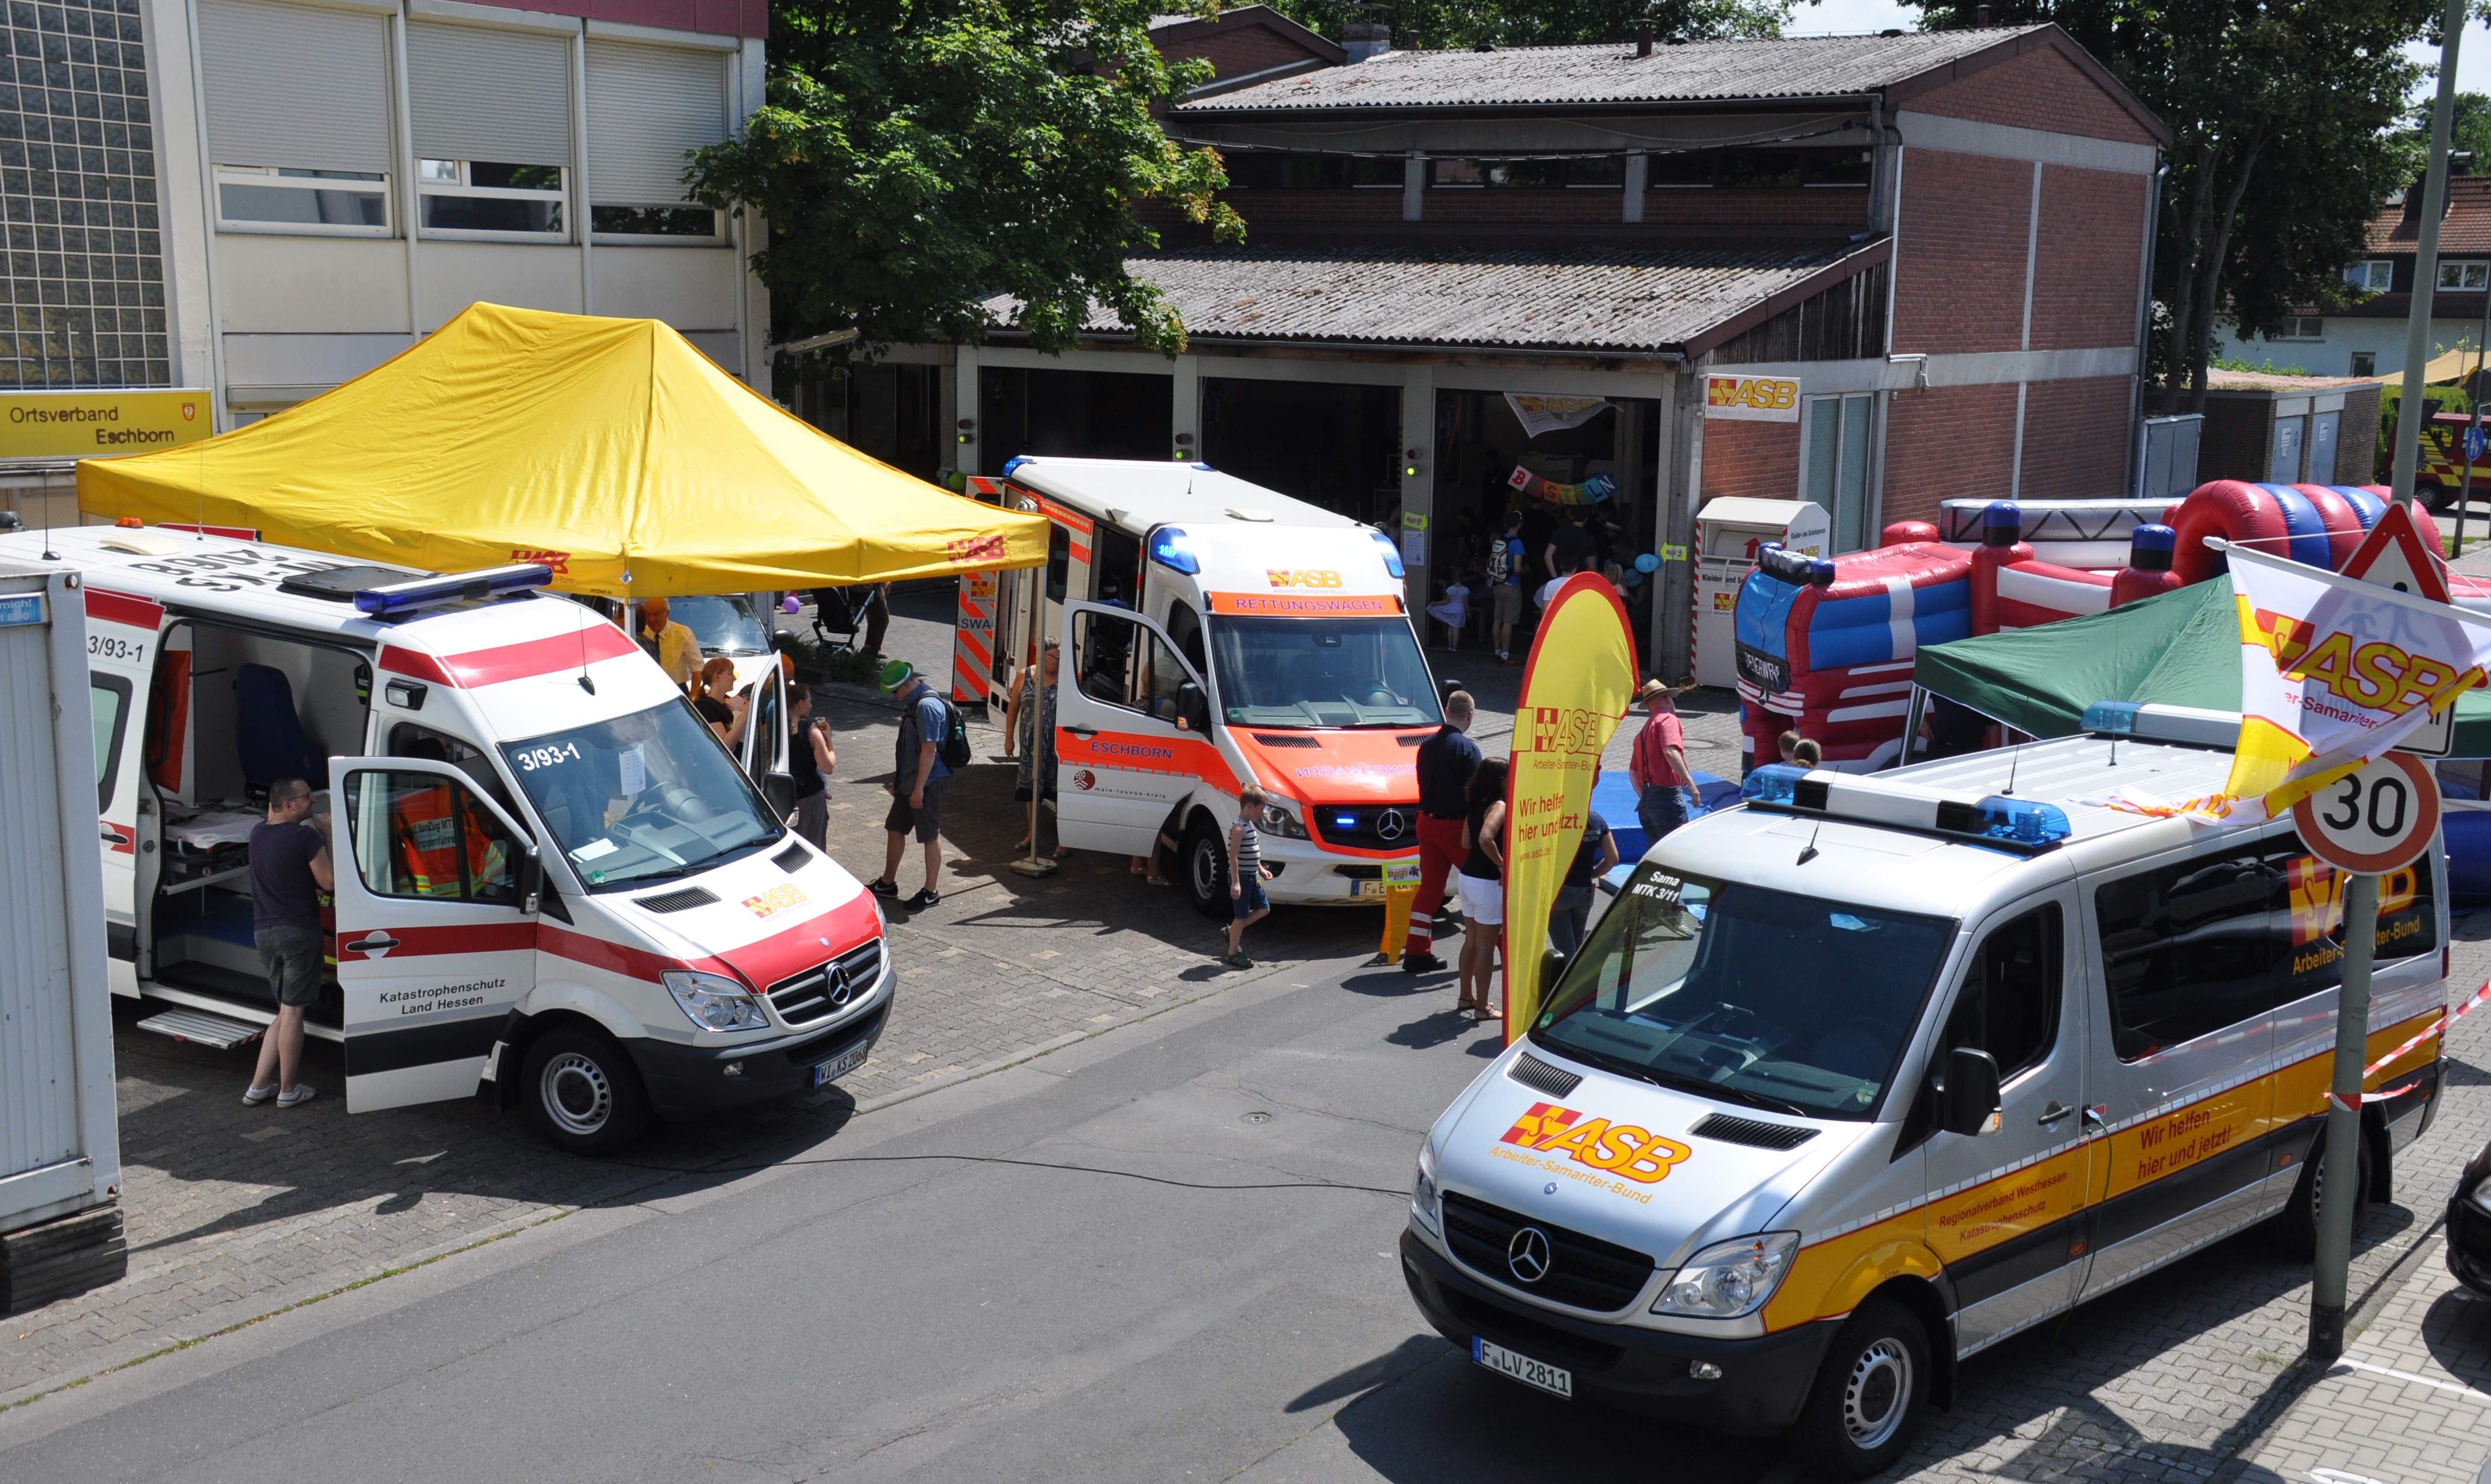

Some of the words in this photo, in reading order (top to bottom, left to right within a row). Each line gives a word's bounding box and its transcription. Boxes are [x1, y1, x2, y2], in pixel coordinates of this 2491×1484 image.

[1728, 379, 1797, 409] ASB
[10, 406, 119, 423] Ortsverband
[96, 428, 175, 444] Eschborn
[1511, 470, 1615, 502] BASTELN
[127, 549, 289, 576] 2068
[965, 535, 1005, 564] ASB
[1289, 570, 1343, 588] ASB
[1236, 598, 1384, 611] RETTUNGSWAGEN
[88, 635, 144, 662] 3/93-1
[1549, 708, 1600, 755] ASB
[518, 742, 581, 771] 3/93-1
[1091, 741, 1174, 760] ESCHBORN
[1095, 786, 1166, 799] main-taunus-kreis
[1519, 798, 1537, 818] Wir
[2322, 777, 2407, 838] 30
[1519, 821, 1538, 843] hier
[1541, 816, 1559, 837] und
[1632, 883, 1659, 897] MTK
[1655, 888, 1680, 902] 3/11
[1650, 871, 1681, 887] Sama
[761, 884, 807, 914] ASB
[380, 978, 505, 1003] Katastrophenschutz
[402, 1001, 432, 1014] Land
[438, 996, 483, 1010] Hessen
[837, 1057, 848, 1074] KS
[848, 1045, 866, 1068] 2068
[2141, 1125, 2165, 1150] Wir
[2168, 1110, 2210, 1140] helfen
[1532, 1117, 1692, 1184] ASB
[2138, 1155, 2166, 1179] hier
[2169, 1139, 2196, 1167] und
[2197, 1123, 2231, 1160] jetzt!
[1488, 1146, 1653, 1204] Arbeiter-Samariter-Bund
[1939, 1191, 2015, 1228] Regionalverband
[2017, 1172, 2067, 1199] Westhessen
[1960, 1200, 2046, 1243] Katastrophenschutz
[1482, 1342, 1491, 1361] F
[1502, 1350, 1522, 1375] LV
[1526, 1361, 1569, 1393] 2811
